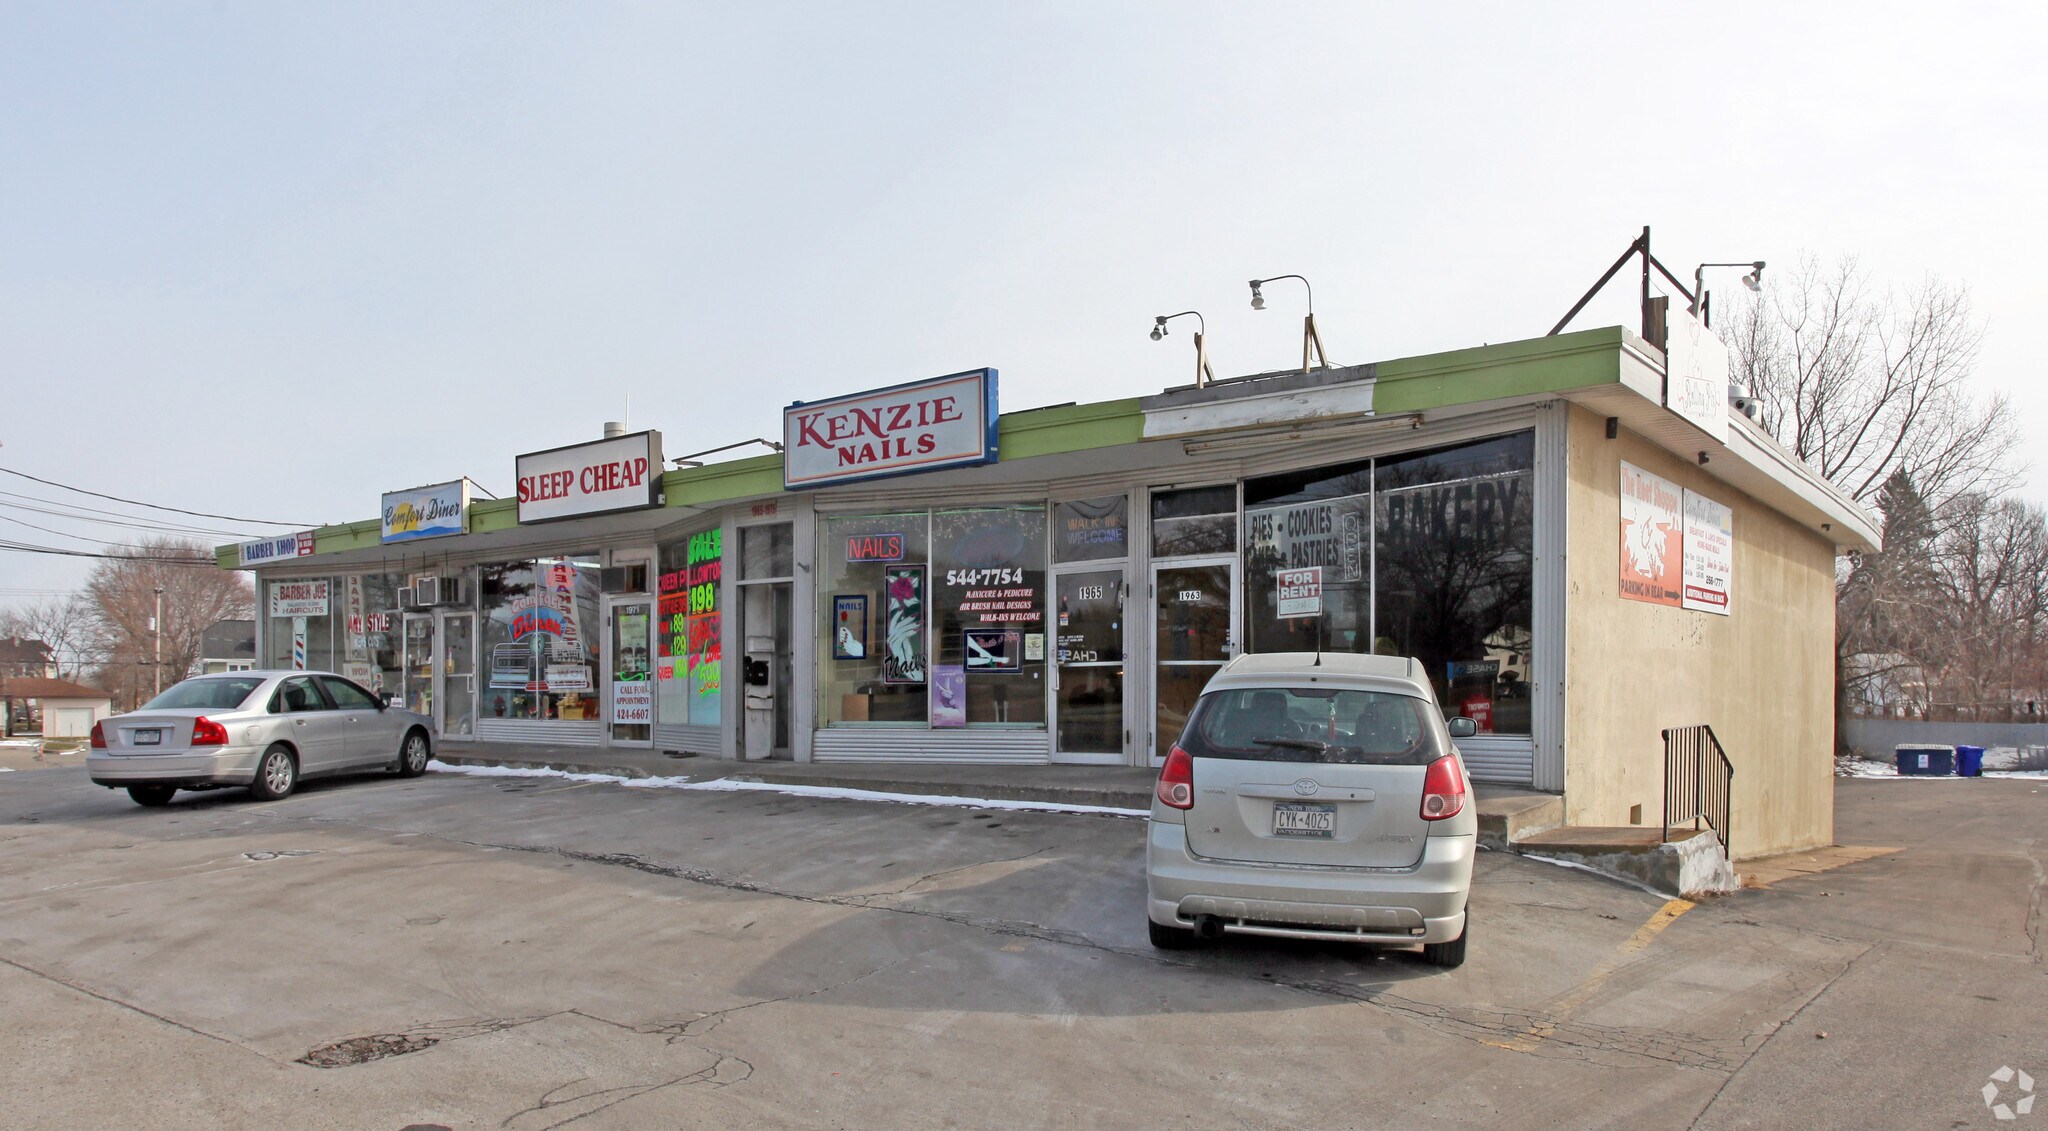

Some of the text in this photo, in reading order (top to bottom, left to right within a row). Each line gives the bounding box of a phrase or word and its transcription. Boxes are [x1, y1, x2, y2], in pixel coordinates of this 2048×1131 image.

[797, 396, 963, 450] KENZIE
[838, 433, 936, 467] NAILS
[518, 457, 648, 504] SLEEP CHEAP
[384, 498, 460, 531] Comfort Diner
[1288, 506, 1332, 537] COOKIES
[1388, 478, 1519, 550] BAKERY
[1067, 518, 1100, 531] WALK
[1068, 528, 1123, 544] WELCOME
[246, 542, 274, 560] BARBER
[277, 538, 296, 556] SHOP
[688, 527, 722, 565] SALE
[849, 537, 899, 559] NAILS
[1292, 538, 1339, 568] PASTRIES
[1345, 516, 1359, 578] OPEN
[946, 567, 1023, 586] 544-7754
[1284, 572, 1313, 586] FOR
[280, 583, 326, 600] BARBER JOE
[965, 590, 996, 598] MANICURE
[1004, 588, 1033, 597] PEDICURE
[1080, 587, 1102, 599] 1965
[1181, 591, 1200, 600] 1963
[1280, 584, 1318, 599] RENT
[283, 607, 324, 615] HAIRCUTS
[625, 606, 640, 614] 1971
[839, 602, 863, 610] NAILS
[959, 601, 1032, 611] AIR BRUSH NAIL DESIGNS
[367, 613, 389, 632] STYLE
[980, 612, 1040, 621] WALK-INS WELCOME
[513, 613, 562, 639] Diner
[884, 655, 928, 678] Nails
[620, 685, 647, 694] CALL FOR
[616, 696, 649, 705] APPOINTMENT
[616, 708, 649, 720] 424-6607
[1279, 811, 1330, 829] CYK 4025
